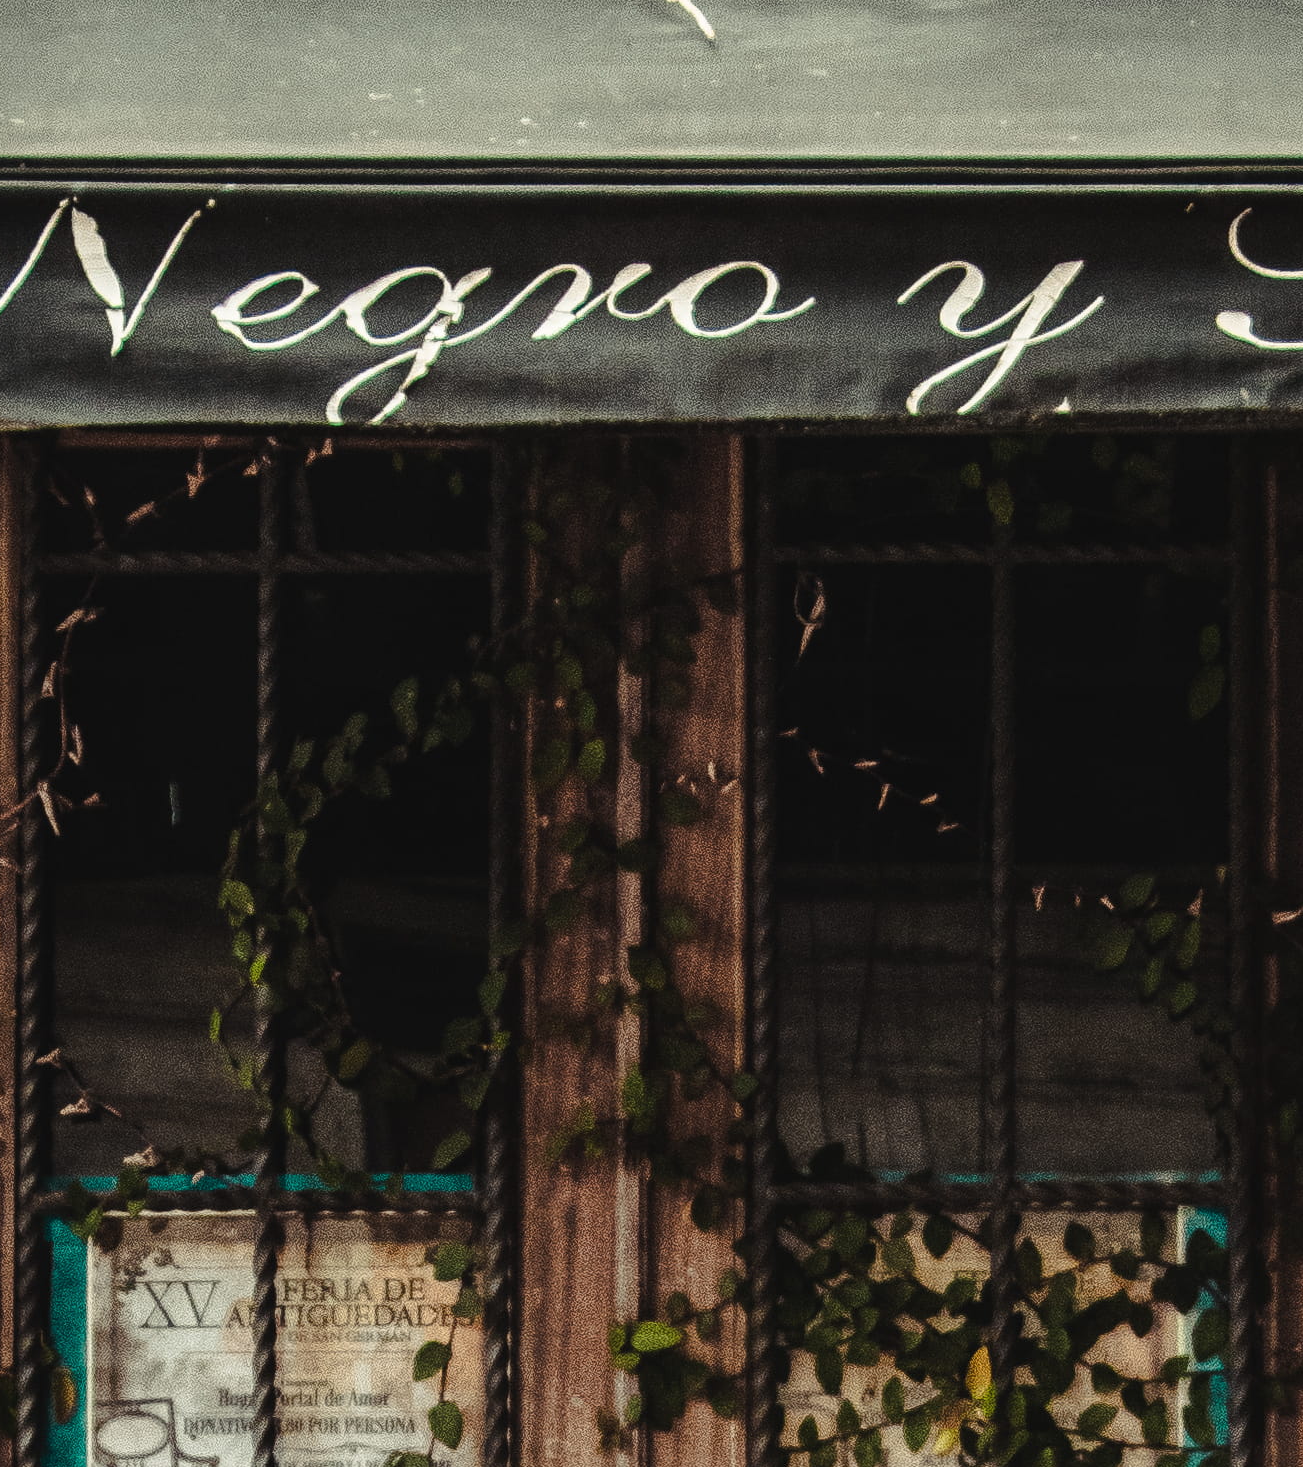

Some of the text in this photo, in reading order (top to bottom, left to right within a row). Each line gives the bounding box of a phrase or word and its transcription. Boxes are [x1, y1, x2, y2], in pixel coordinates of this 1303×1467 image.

[894, 259, 1104, 415] y
[281, 1276, 426, 1302] FERIA DE
[137, 1279, 220, 1329] XV
[324, 1386, 343, 1407] de
[349, 1386, 390, 1408] Amor
[308, 1415, 416, 1435] POR PERSONA
